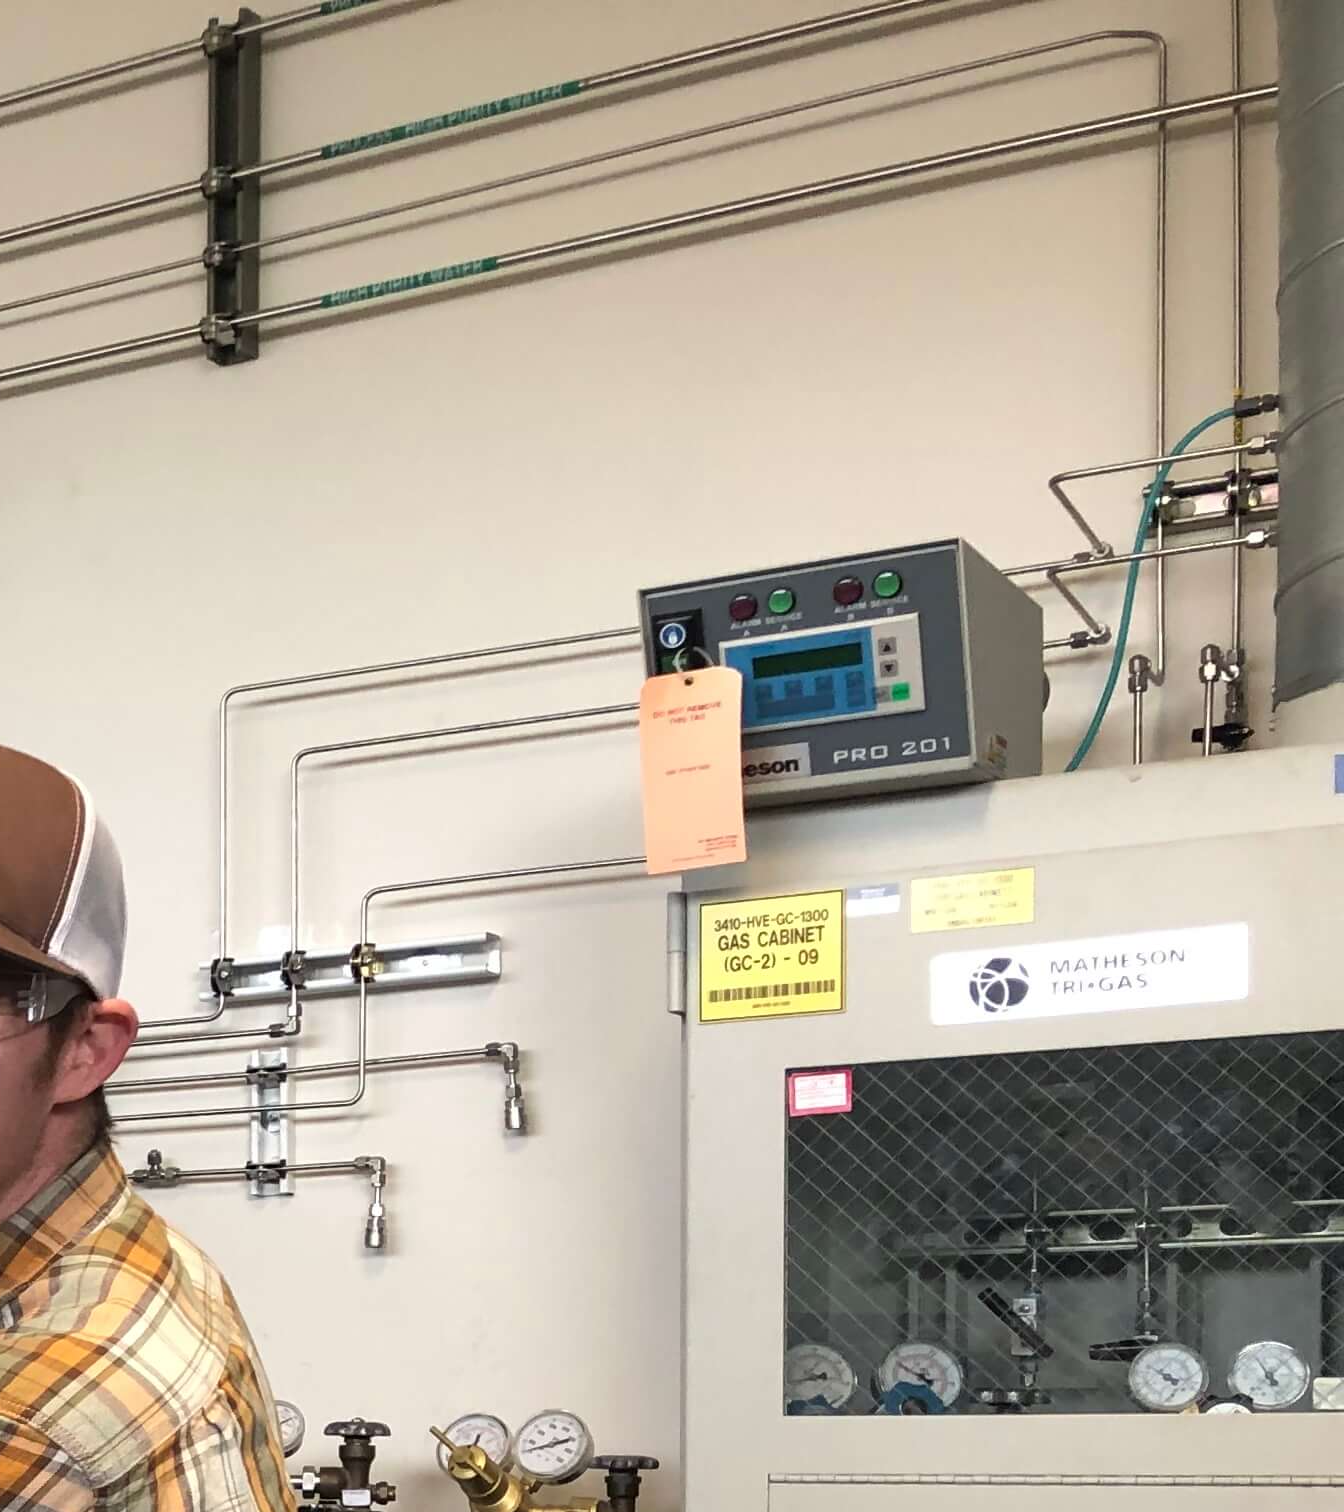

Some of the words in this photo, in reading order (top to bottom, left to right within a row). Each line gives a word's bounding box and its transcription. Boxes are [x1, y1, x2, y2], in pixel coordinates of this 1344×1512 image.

[730, 618, 762, 631] ALARM
[832, 745, 889, 764] PRO
[901, 736, 952, 757] 201
[742, 756, 800, 778] eson
[714, 908, 830, 933] 3410-HVE-GC-1300
[717, 932, 751, 952] GAS
[757, 925, 825, 948] CABINET
[724, 952, 777, 973] (GC-2)
[798, 948, 820, 966] 09
[1050, 948, 1186, 976] MATHESON
